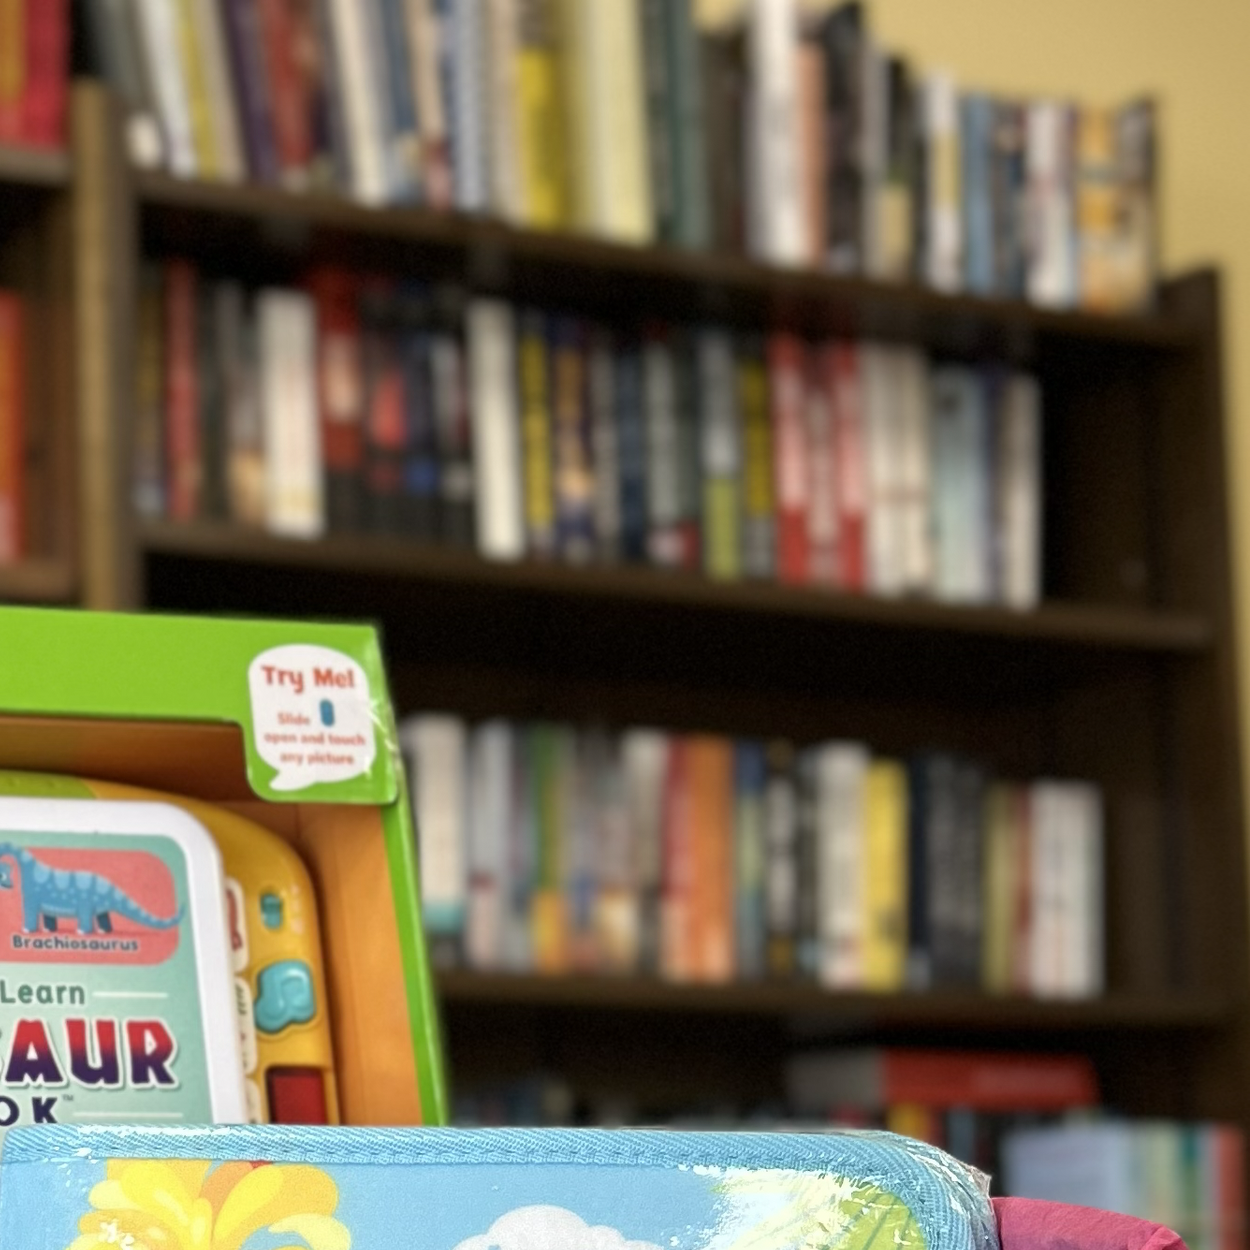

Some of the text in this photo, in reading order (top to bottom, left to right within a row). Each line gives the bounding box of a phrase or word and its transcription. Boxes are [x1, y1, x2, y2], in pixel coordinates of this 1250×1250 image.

[261, 665, 356, 694] Try Me!
[300, 733, 325, 744] and
[12, 935, 138, 952] Brachiosaurus
[0, 979, 86, 1005] Learn
